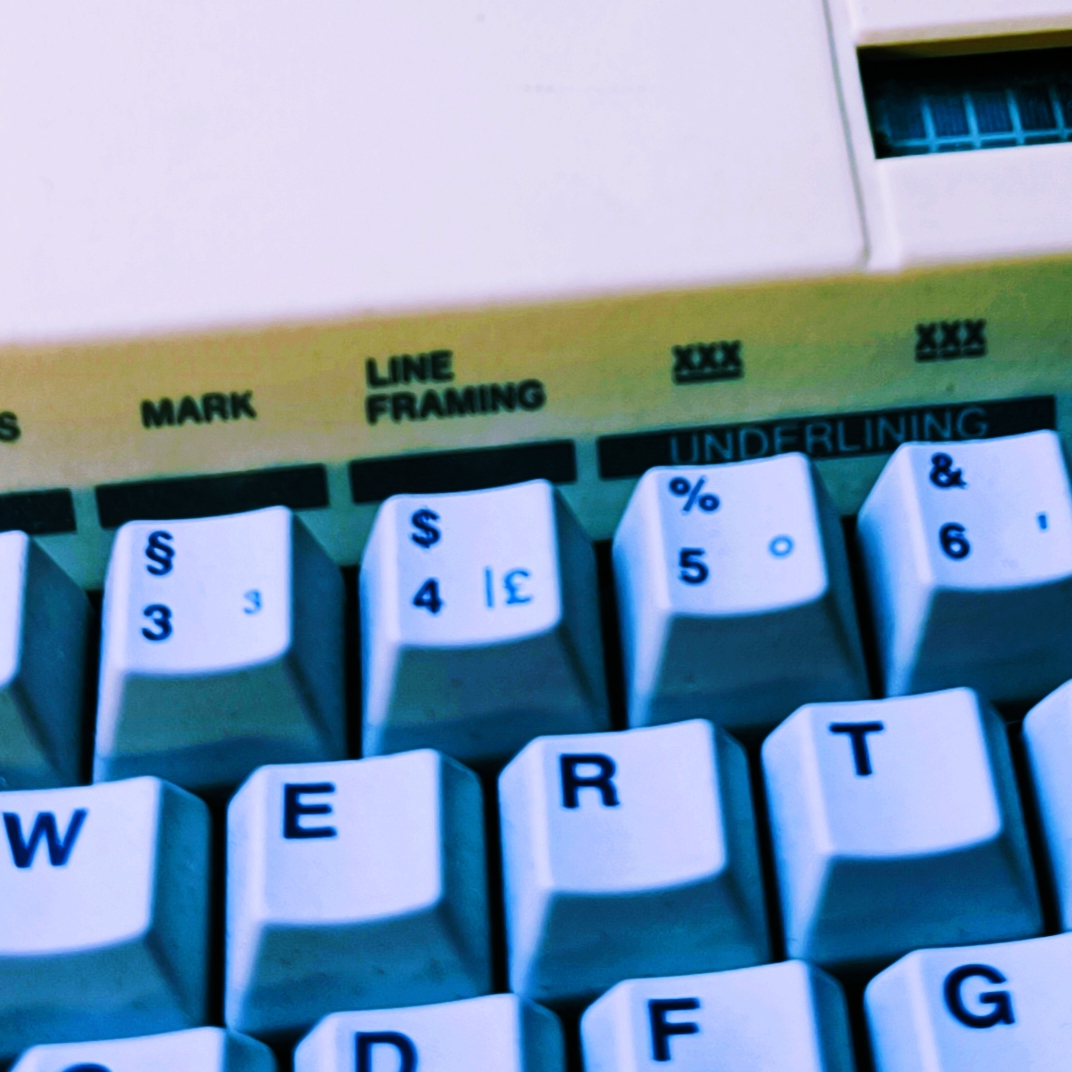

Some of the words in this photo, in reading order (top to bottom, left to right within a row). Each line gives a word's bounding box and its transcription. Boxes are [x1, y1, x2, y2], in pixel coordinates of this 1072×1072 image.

[365, 349, 455, 389] LINE
[139, 389, 257, 429] MARK
[365, 378, 547, 425] FRAMING
[669, 406, 989, 465] UNDERLINING
[928, 451, 968, 491] &
[667, 475, 721, 515] %
[409, 507, 442, 550] $
[937, 521, 972, 562] 6
[144, 529, 176, 578] §
[677, 546, 710, 587] 5
[410, 577, 445, 616] 4
[140, 603, 174, 643] 3
[826, 720, 886, 779] T
[557, 752, 621, 811] R
[281, 781, 338, 841] E
[1, 807, 89, 870] W
[941, 963, 1017, 1031] G
[352, 1031, 419, 1072] D
[645, 996, 702, 1064] F
